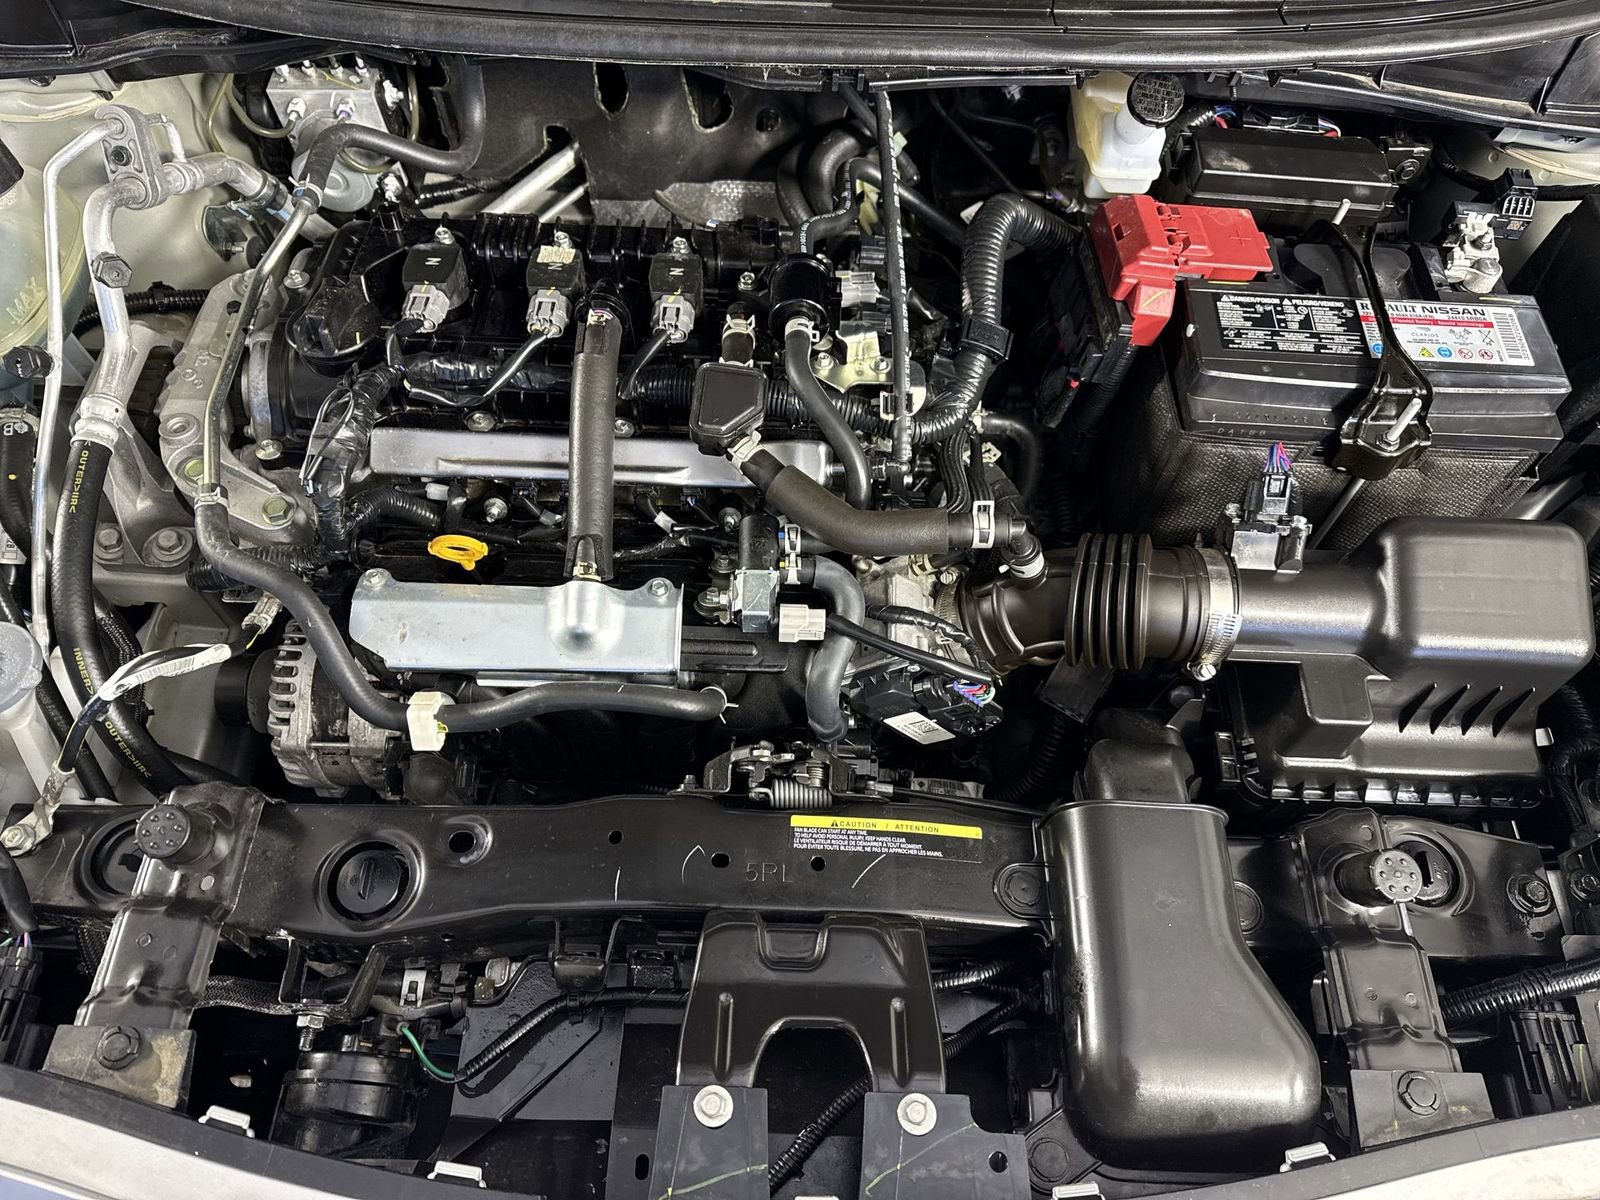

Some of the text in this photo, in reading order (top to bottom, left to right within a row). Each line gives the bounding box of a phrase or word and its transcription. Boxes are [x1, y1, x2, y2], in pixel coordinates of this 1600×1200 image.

[1421, 306, 1485, 316] NISSAN
[840, 820, 877, 829] CAUTION
[895, 823, 939, 833] ATTENTION
[856, 839, 882, 847] DÉMARRER
[746, 863, 793, 882] 5RL
